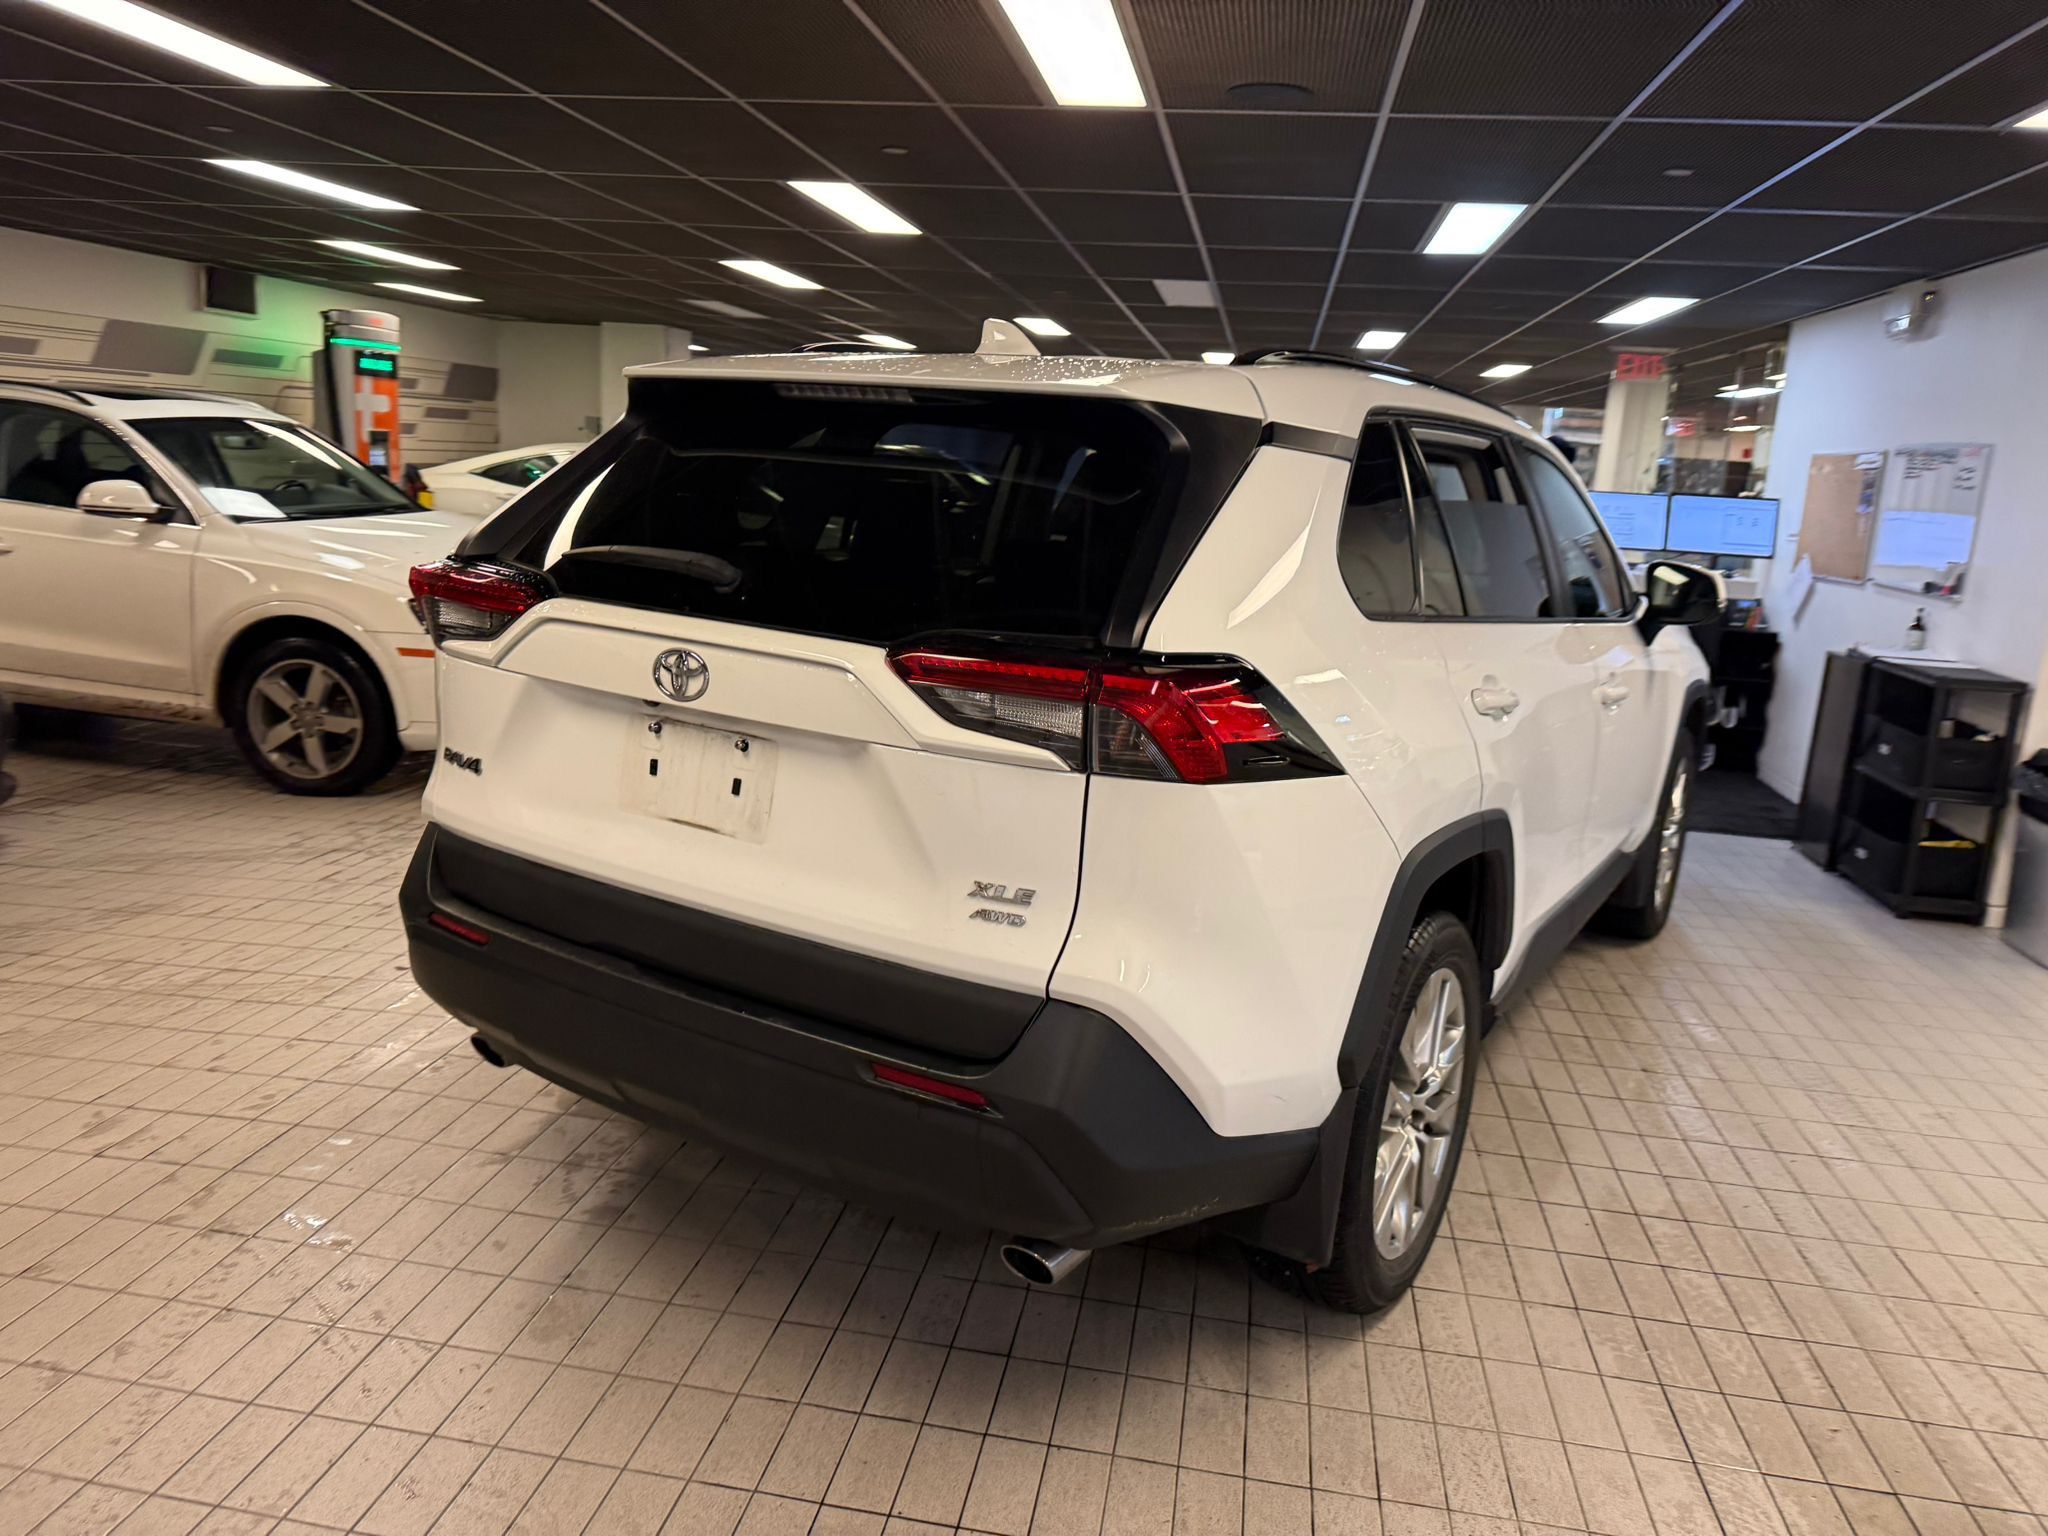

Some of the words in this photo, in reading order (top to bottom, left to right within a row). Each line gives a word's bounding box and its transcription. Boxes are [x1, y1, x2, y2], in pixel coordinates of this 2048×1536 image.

[443, 747, 482, 776] RAV4
[967, 880, 1036, 905] XLE
[968, 908, 1026, 927] AWD
